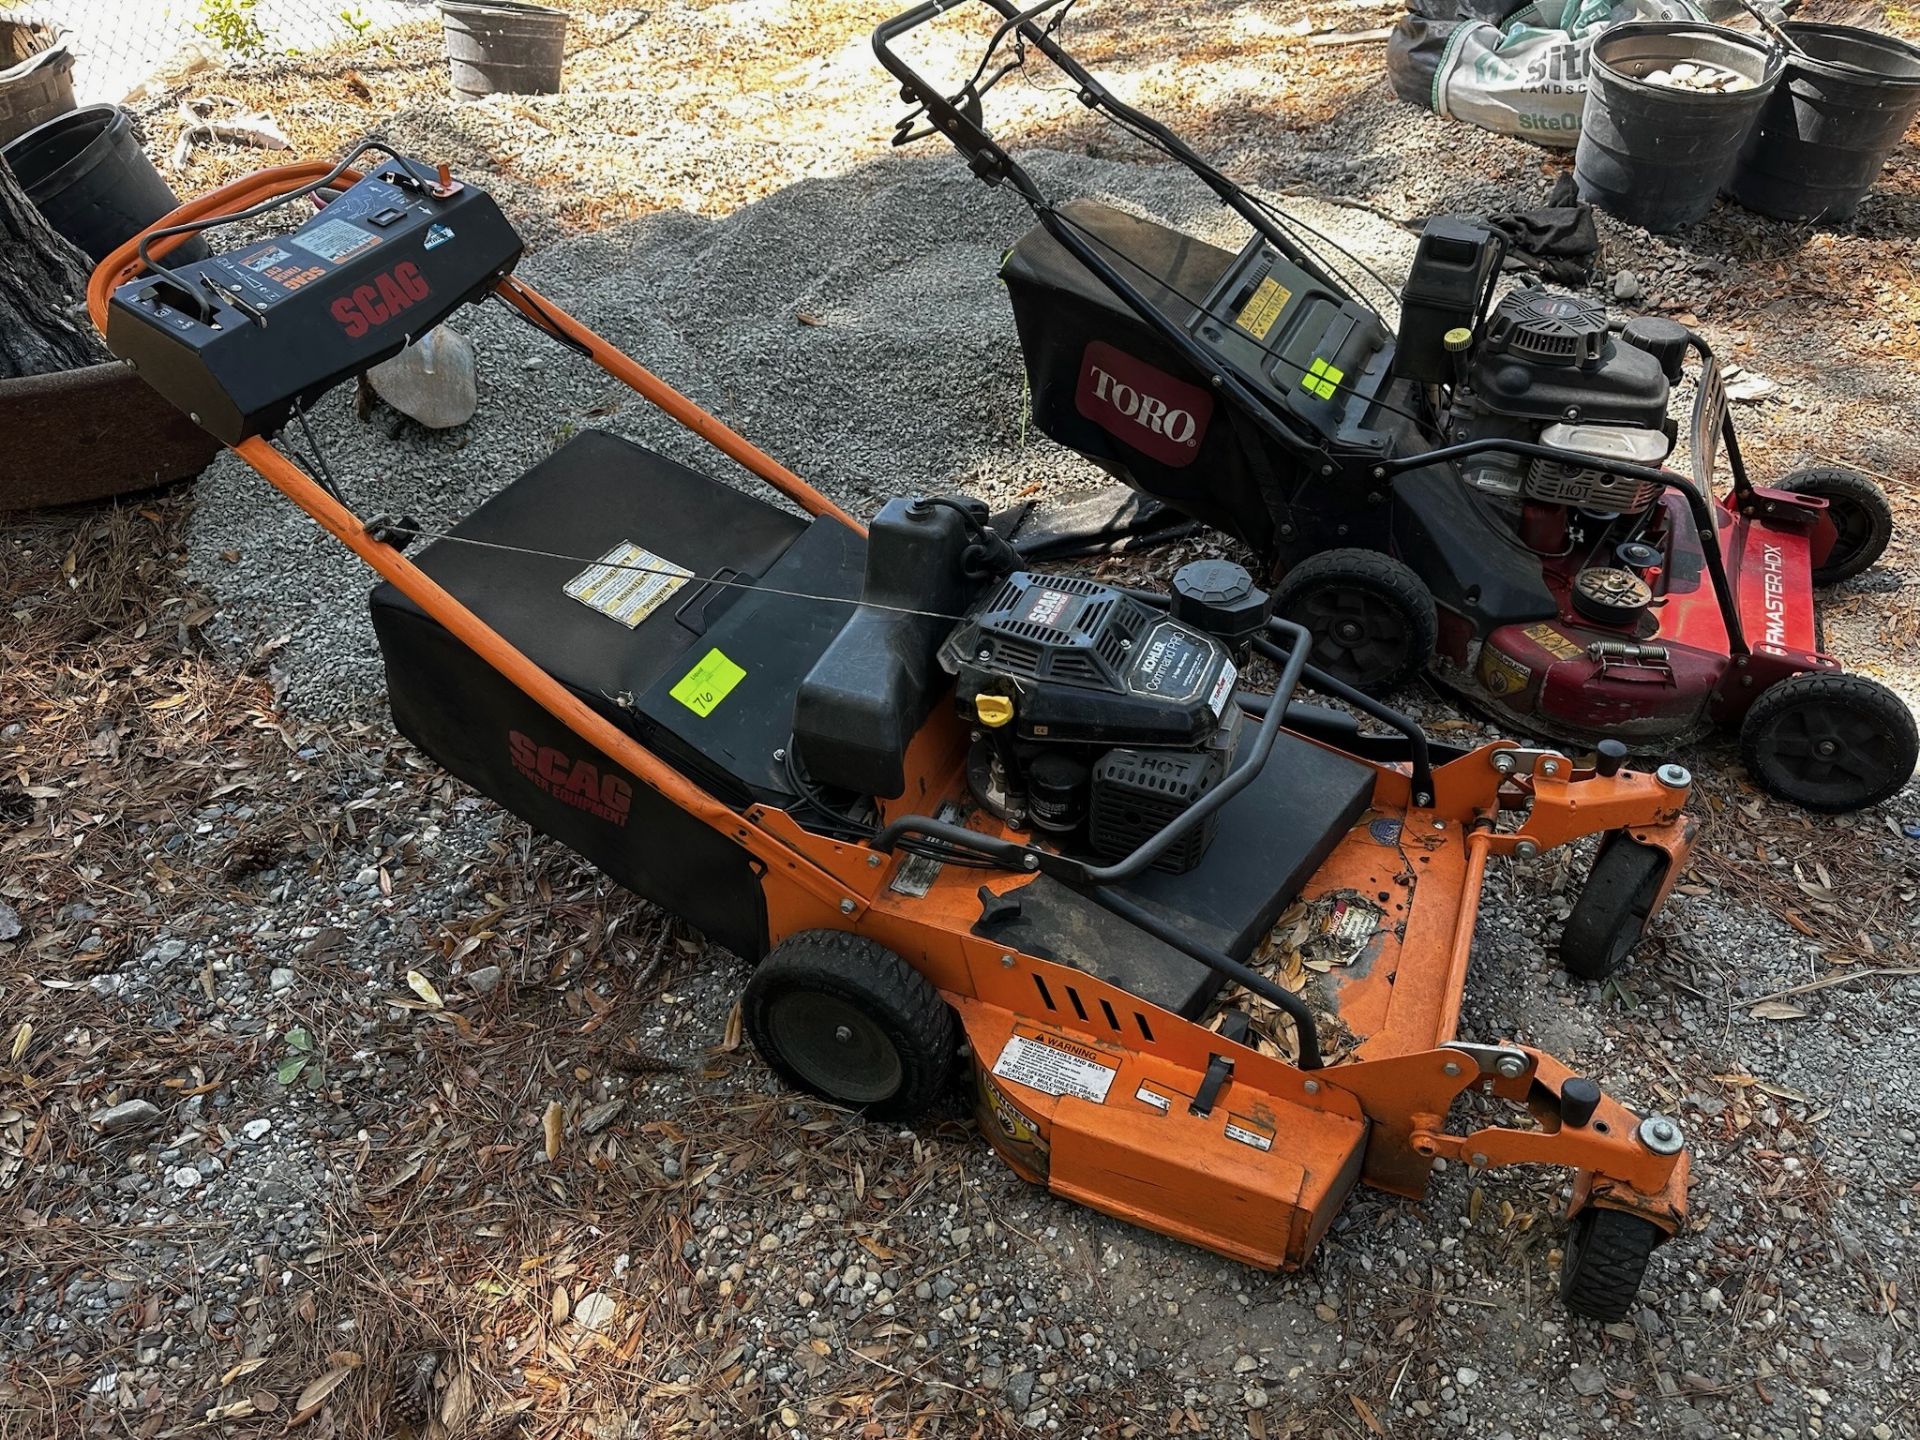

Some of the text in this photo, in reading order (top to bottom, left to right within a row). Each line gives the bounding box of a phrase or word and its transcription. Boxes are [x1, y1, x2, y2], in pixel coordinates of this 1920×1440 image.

[283, 267, 327, 291] SCAG
[330, 263, 430, 338] SCAG
[1090, 365, 1197, 447] TORO
[1558, 482, 1594, 498] HOT
[1764, 544, 1781, 573] HDX
[1029, 590, 1061, 623] SCAG
[1141, 641, 1167, 673] KOHLER
[1146, 632, 1185, 690] Command PRO
[693, 691, 713, 709] 76
[509, 730, 633, 813] SCAG
[1141, 755, 1189, 778] HOT
[553, 785, 629, 827] EQUIPMENT
[1019, 1038, 1106, 1073] ROTATING BLADES AND BELTS
[1047, 1037, 1097, 1060] WARNING
[999, 1069, 1032, 1084] DISCHARGE
[1033, 1082, 1052, 1092] CHUTE
[1013, 1064, 1025, 1072] NOT
[1026, 1069, 1053, 1081] OPERATE
[1054, 1079, 1077, 1090] UNLESS
[1037, 1078, 1068, 1092] MULCHING
